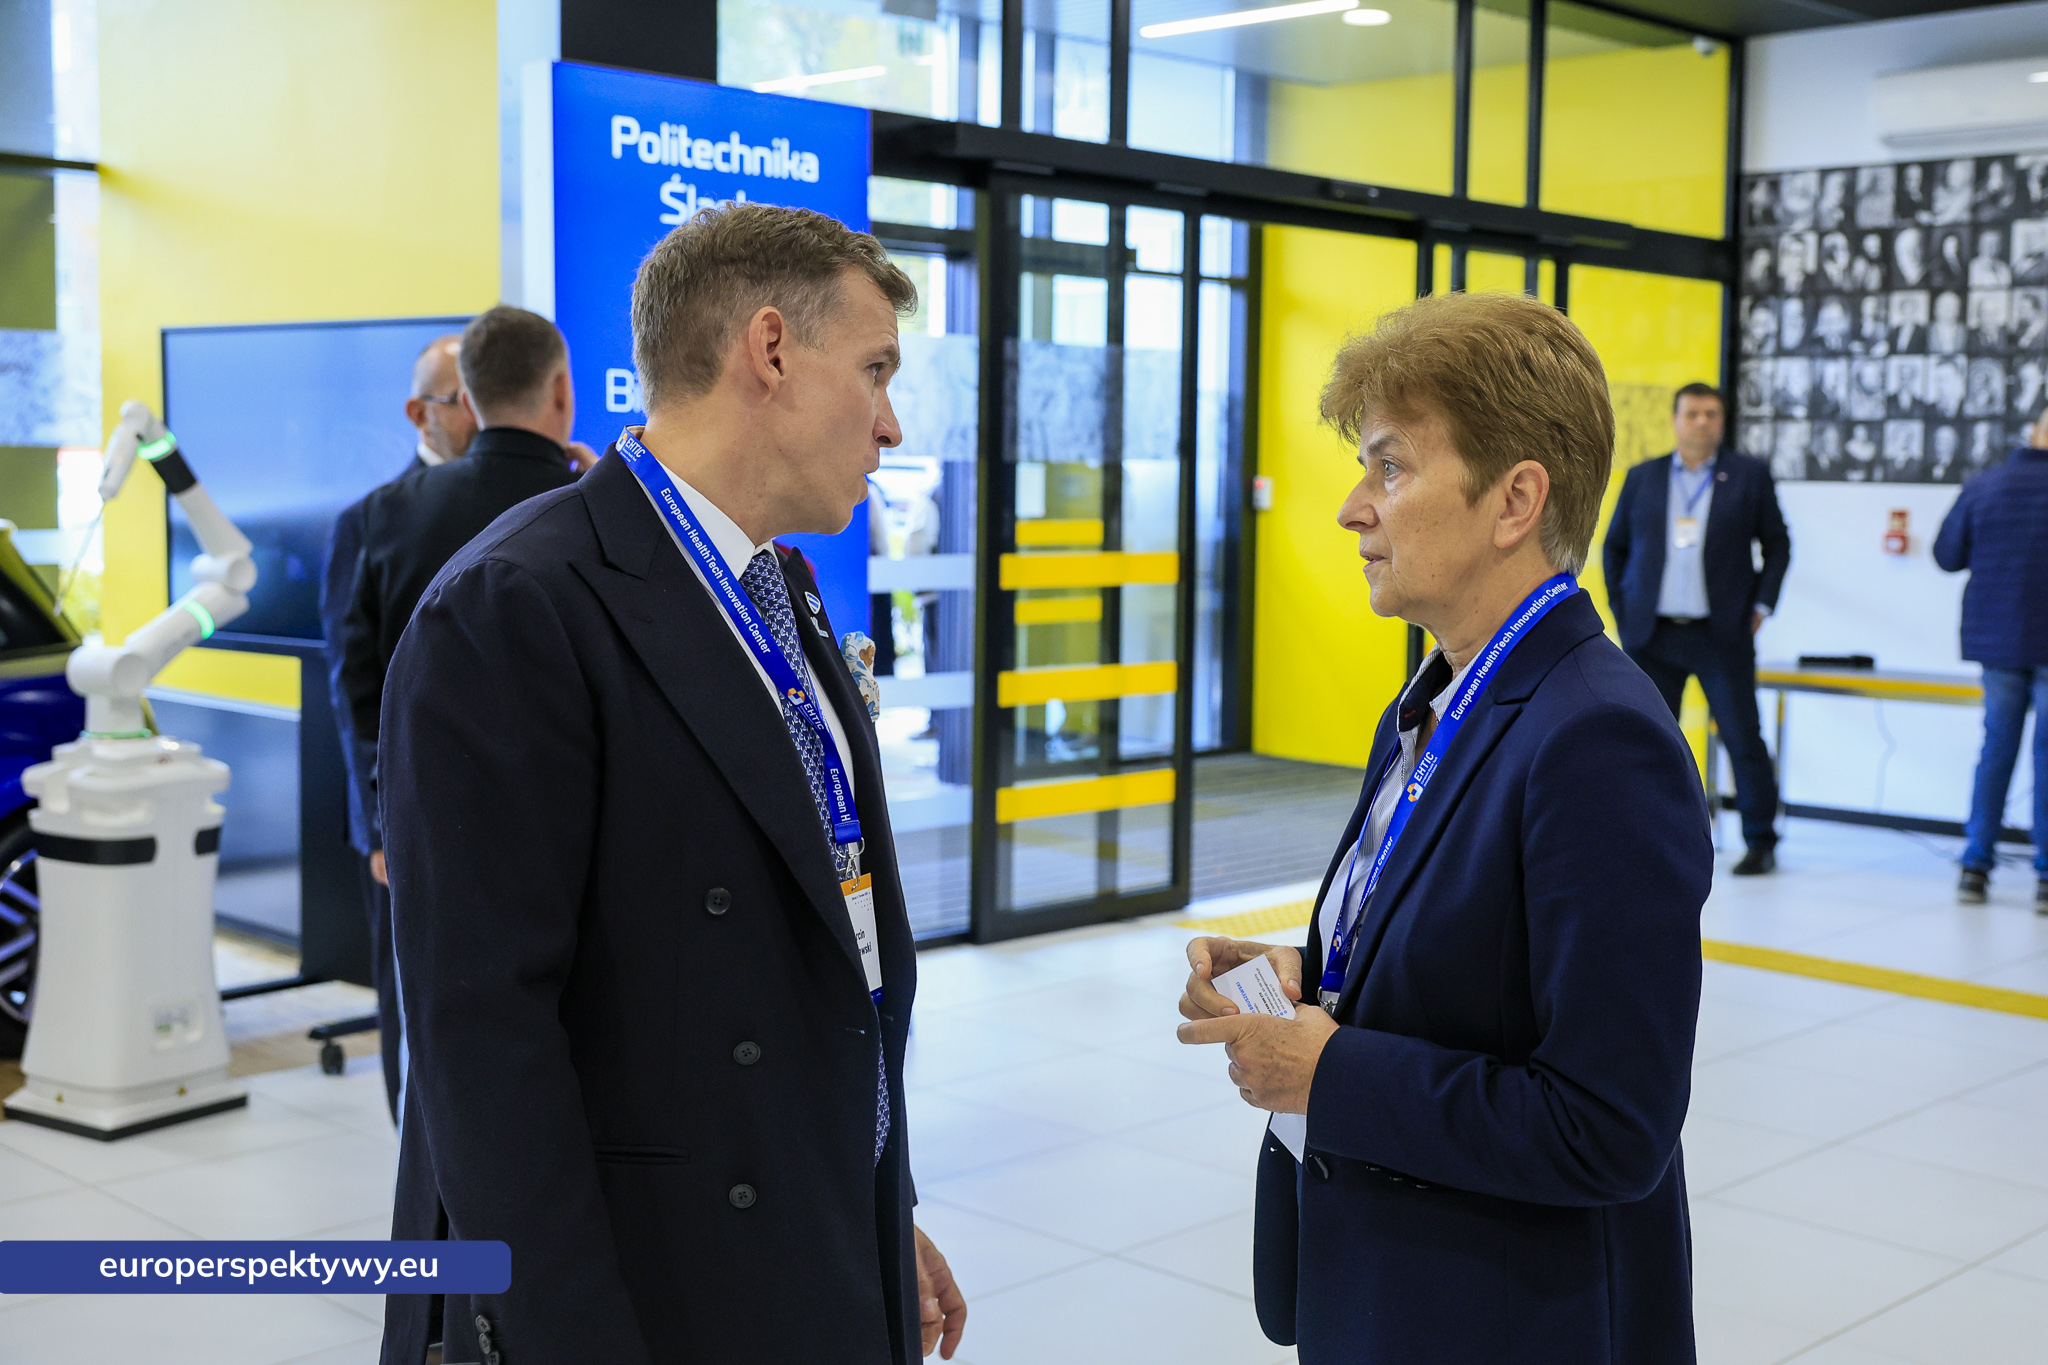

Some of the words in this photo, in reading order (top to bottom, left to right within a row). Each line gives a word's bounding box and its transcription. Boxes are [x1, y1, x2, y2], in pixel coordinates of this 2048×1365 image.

[611, 115, 819, 183] Politechnika
[626, 437, 646, 458] EHTIC
[660, 487, 690, 531] European
[718, 577, 750, 626] Innovation
[748, 622, 771, 655] Center
[1450, 677, 1482, 721] European
[1510, 594, 1550, 633] Innovation
[1545, 581, 1569, 598] Center
[804, 703, 824, 731] EHTIC
[1414, 751, 1434, 782] EHTIC
[830, 768, 847, 813] European
[1377, 835, 1393, 866] Center
